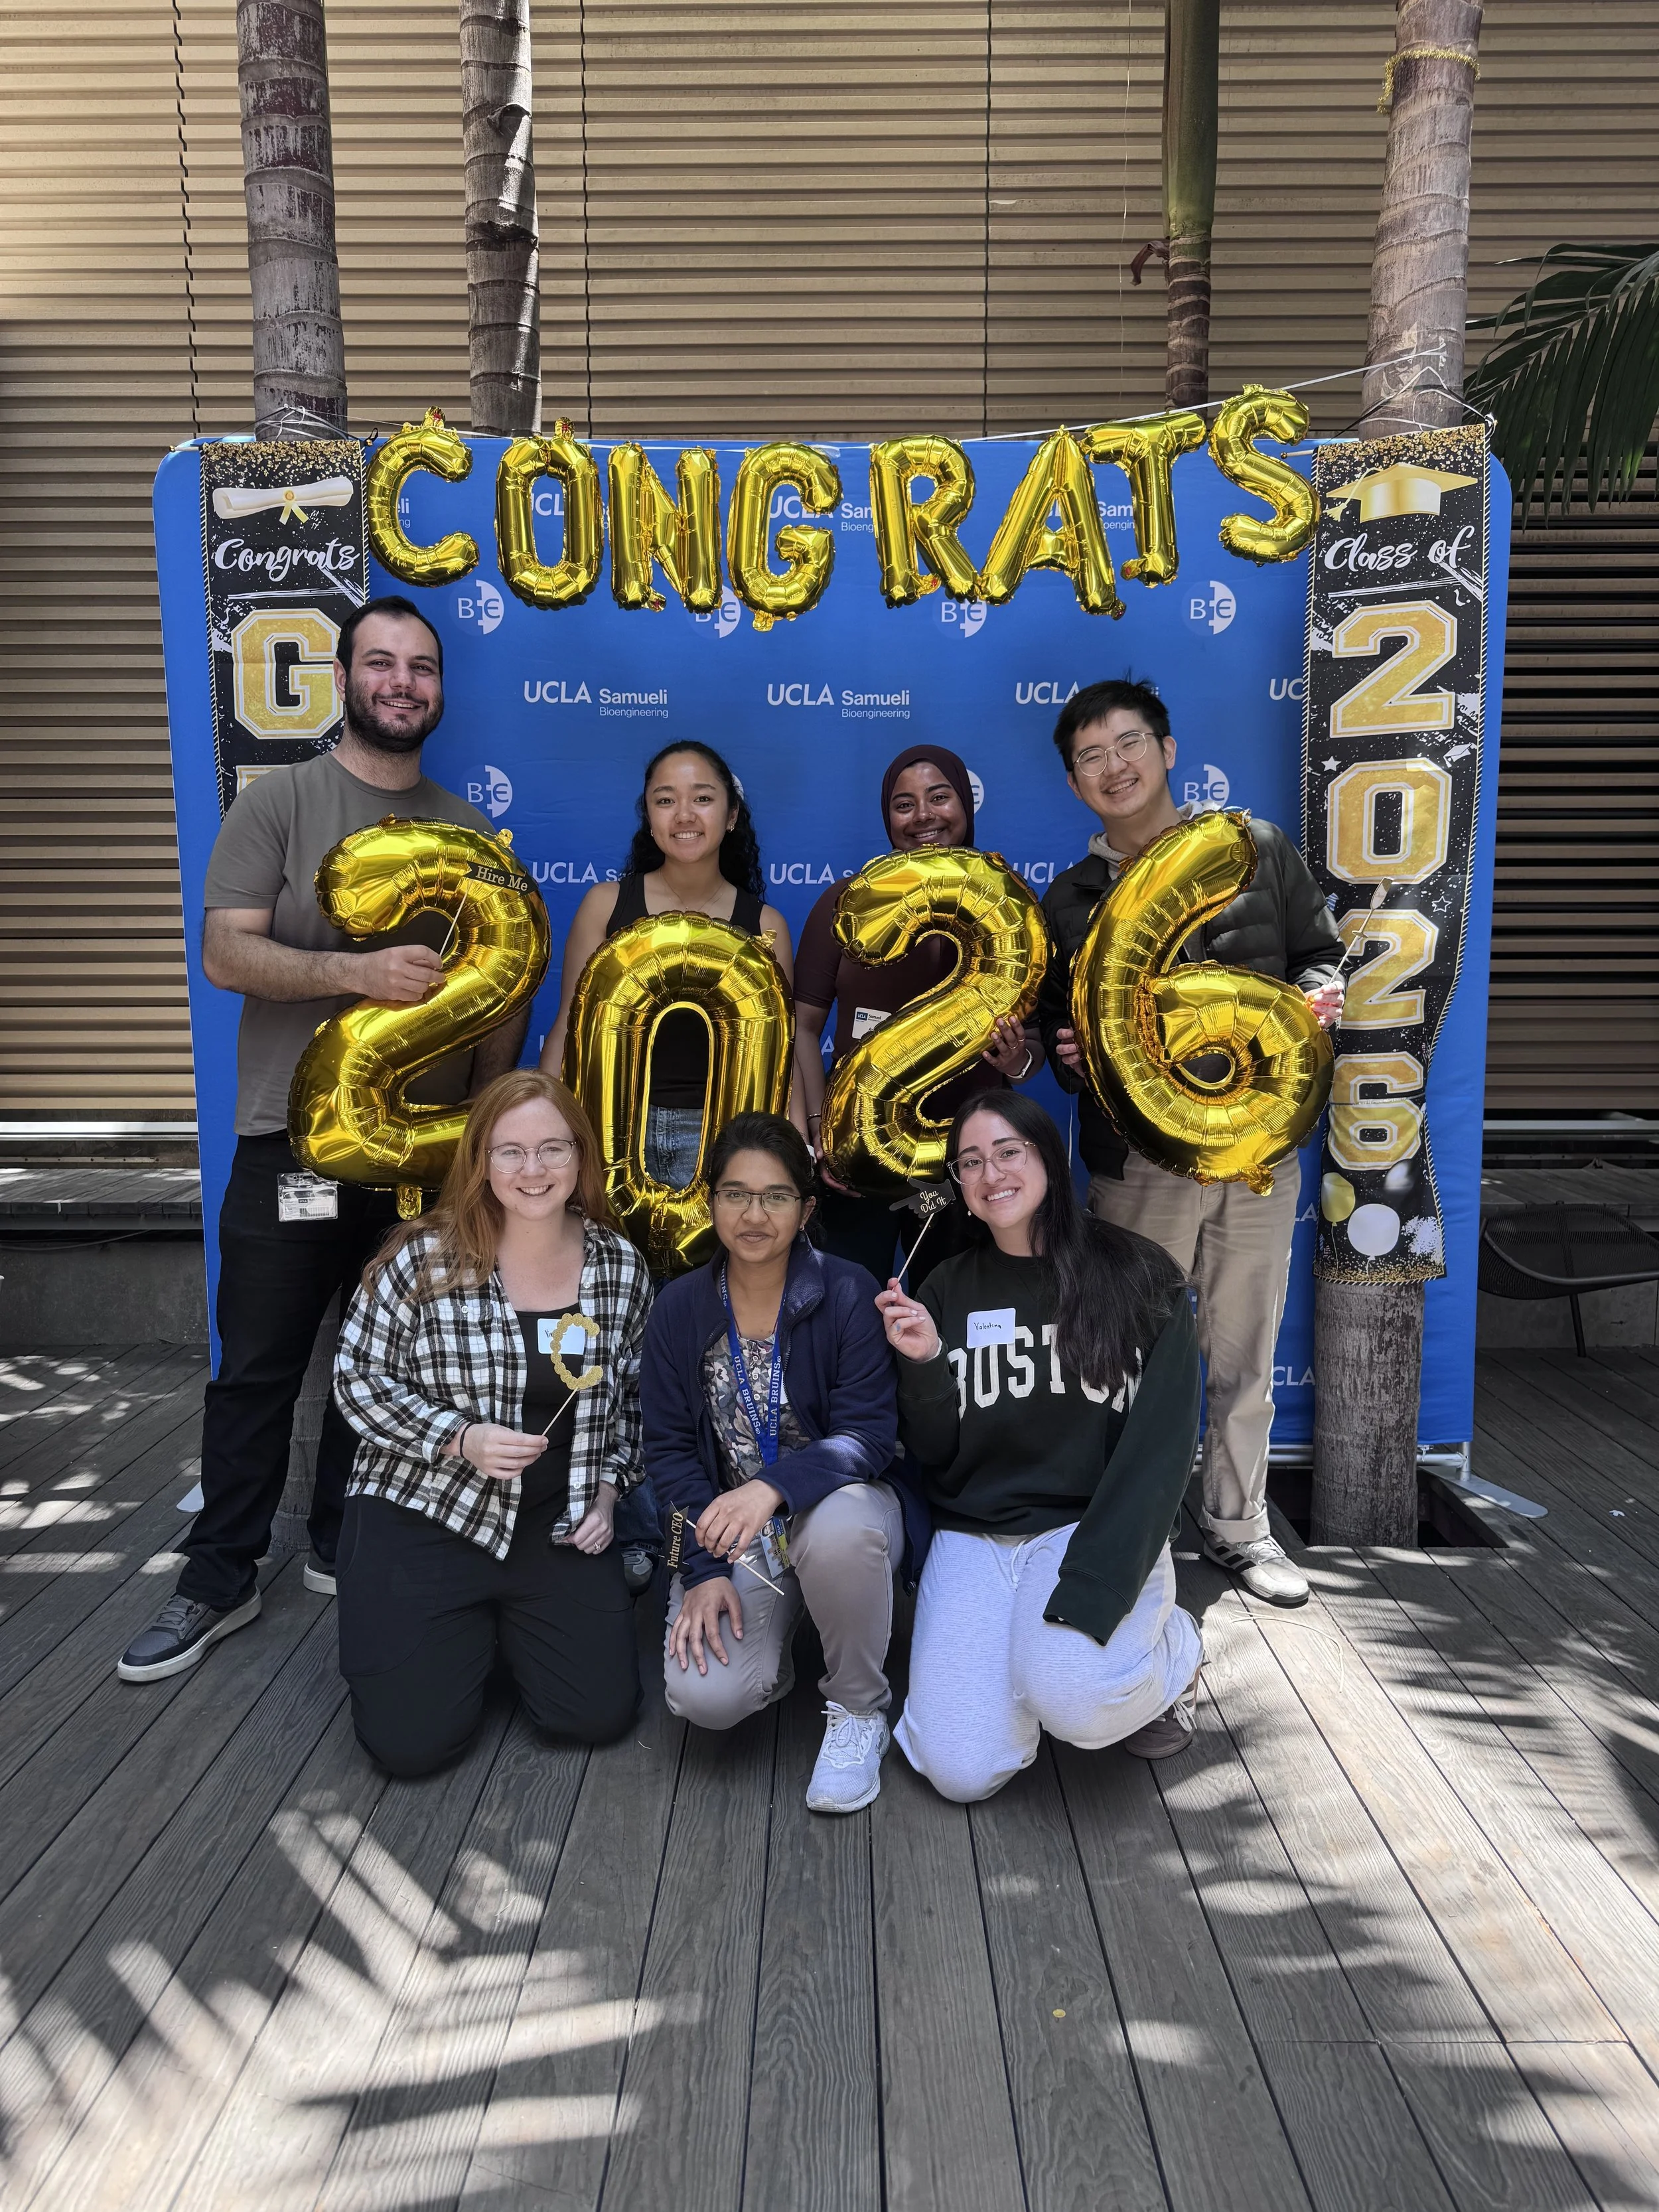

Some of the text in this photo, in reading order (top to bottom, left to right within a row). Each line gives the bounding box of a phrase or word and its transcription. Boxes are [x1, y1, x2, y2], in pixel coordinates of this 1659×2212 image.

[366, 384, 1321, 629] CONGRATS
[215, 538, 360, 581] Congrats
[1325, 526, 1475, 571] Class of
[524, 681, 668, 705] UCLA Samueli
[767, 683, 909, 706] UCLA Samueli
[1269, 678, 1303, 700] UC
[600, 707, 668, 718] Bioengineering
[841, 709, 910, 719] Bioengineering
[475, 865, 528, 891] Hire Me
[533, 861, 599, 883] UCLA
[770, 863, 835, 884] UCLA
[287, 811, 1334, 1274] 2026
[920, 1190, 939, 1205] You
[920, 1196, 946, 1213] Did It
[734, 1356, 745, 1384] UCLA
[1273, 1366, 1315, 1386] CLA
[667, 1512, 684, 1568] Future CEO
